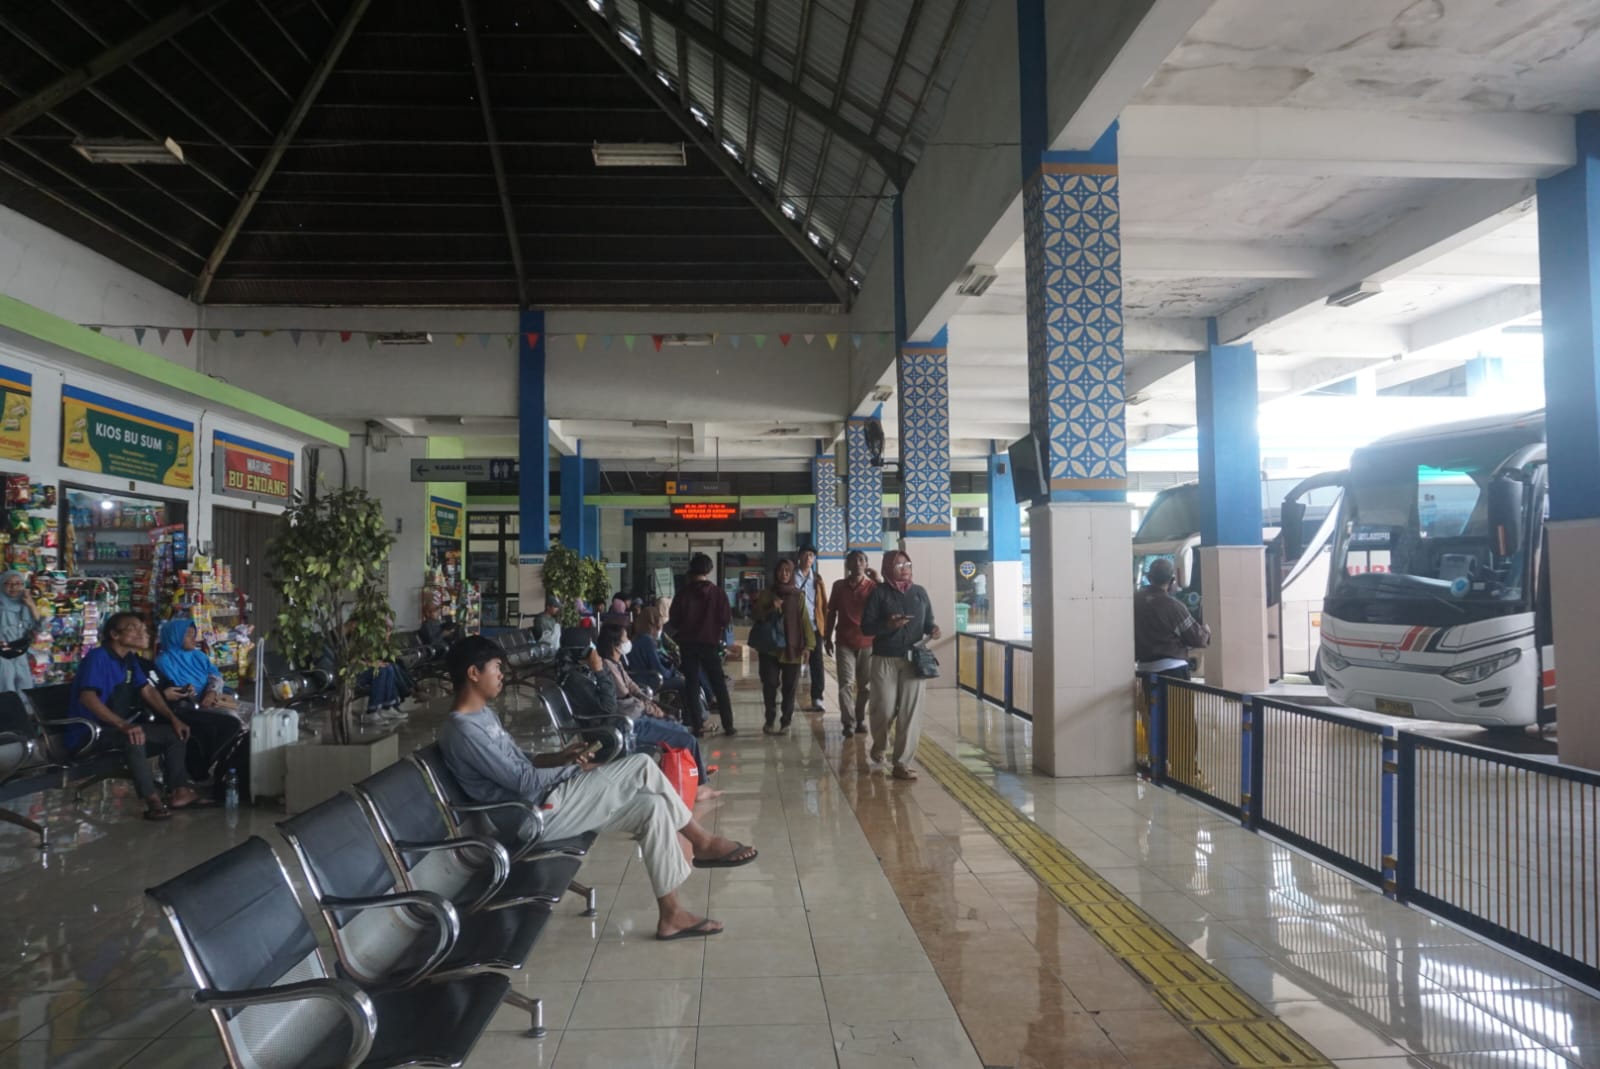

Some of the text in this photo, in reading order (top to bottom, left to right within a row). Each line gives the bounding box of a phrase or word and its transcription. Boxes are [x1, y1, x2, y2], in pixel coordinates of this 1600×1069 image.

[95, 422, 162, 451] KIOS BU SUM
[228, 470, 288, 497] BU ENDANG
